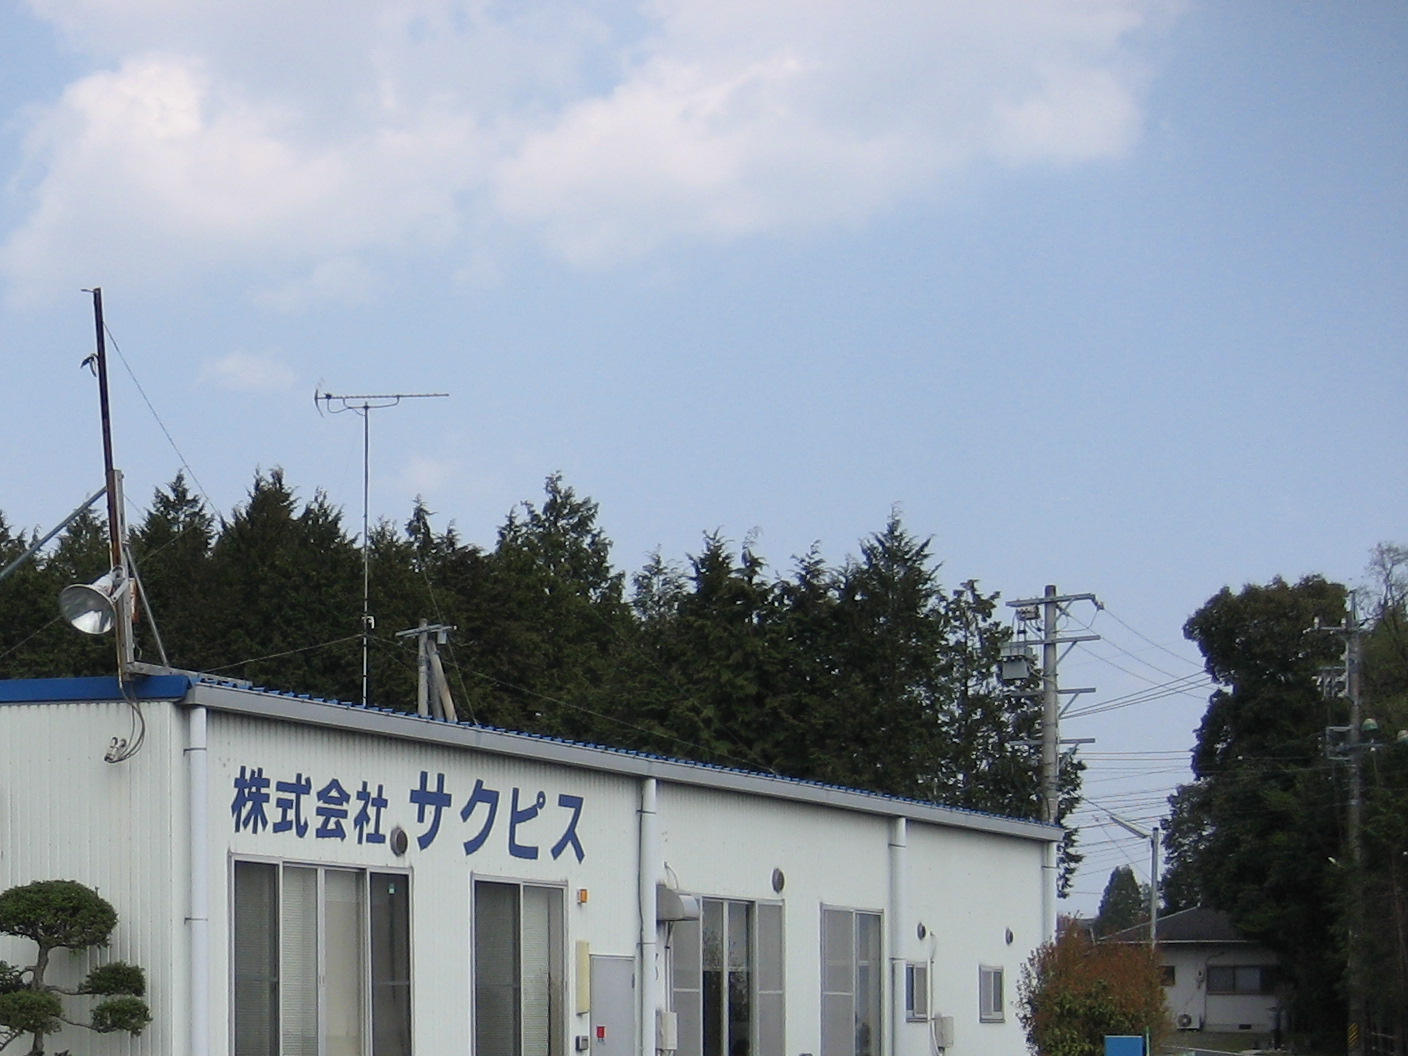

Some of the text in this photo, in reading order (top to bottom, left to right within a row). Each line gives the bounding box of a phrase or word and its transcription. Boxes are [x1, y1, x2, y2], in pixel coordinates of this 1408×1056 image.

[231, 765, 585, 864] 株式会社 サクピス
